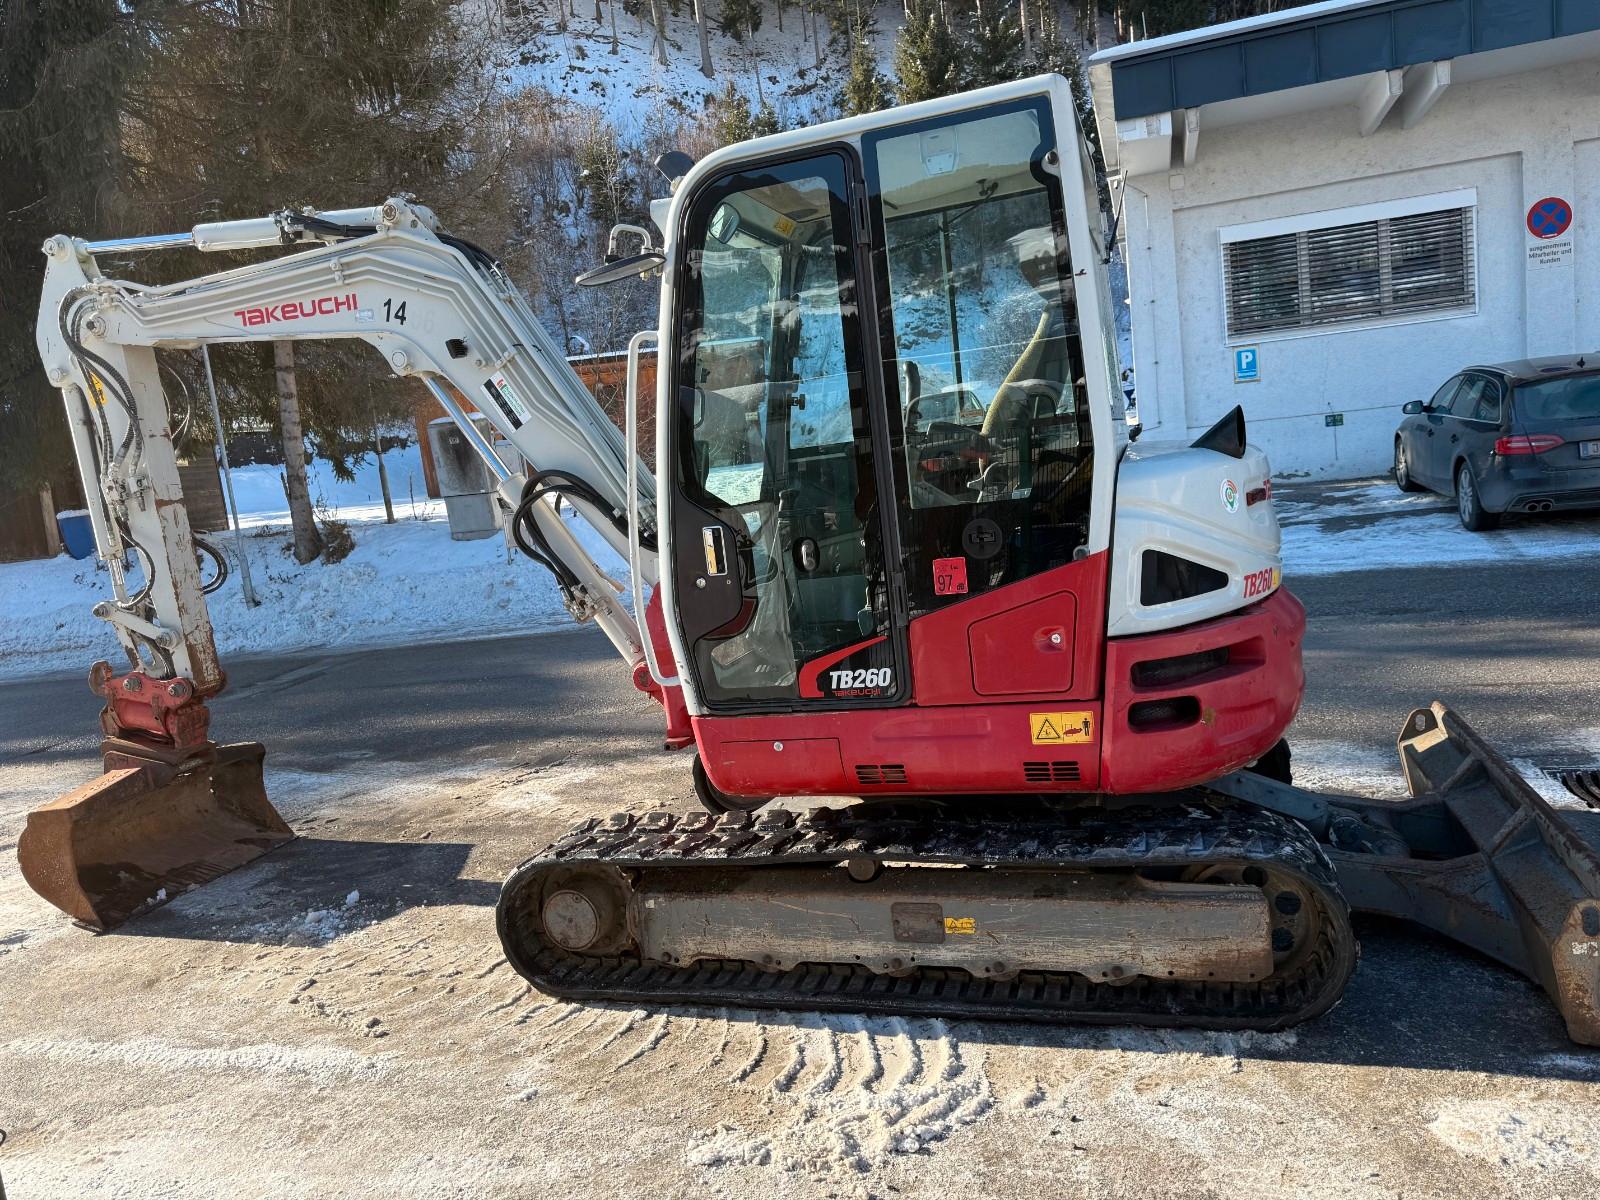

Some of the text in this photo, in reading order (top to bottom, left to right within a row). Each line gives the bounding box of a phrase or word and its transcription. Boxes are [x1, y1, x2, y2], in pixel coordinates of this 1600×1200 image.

[1528, 249, 1559, 259] Mitarbeiter
[1529, 242, 1571, 252] ausgenommen
[383, 298, 407, 326] 14
[1241, 351, 1253, 368] P
[937, 574, 953, 592] 97
[1243, 567, 1273, 598] TB260
[829, 667, 892, 689] TB260
